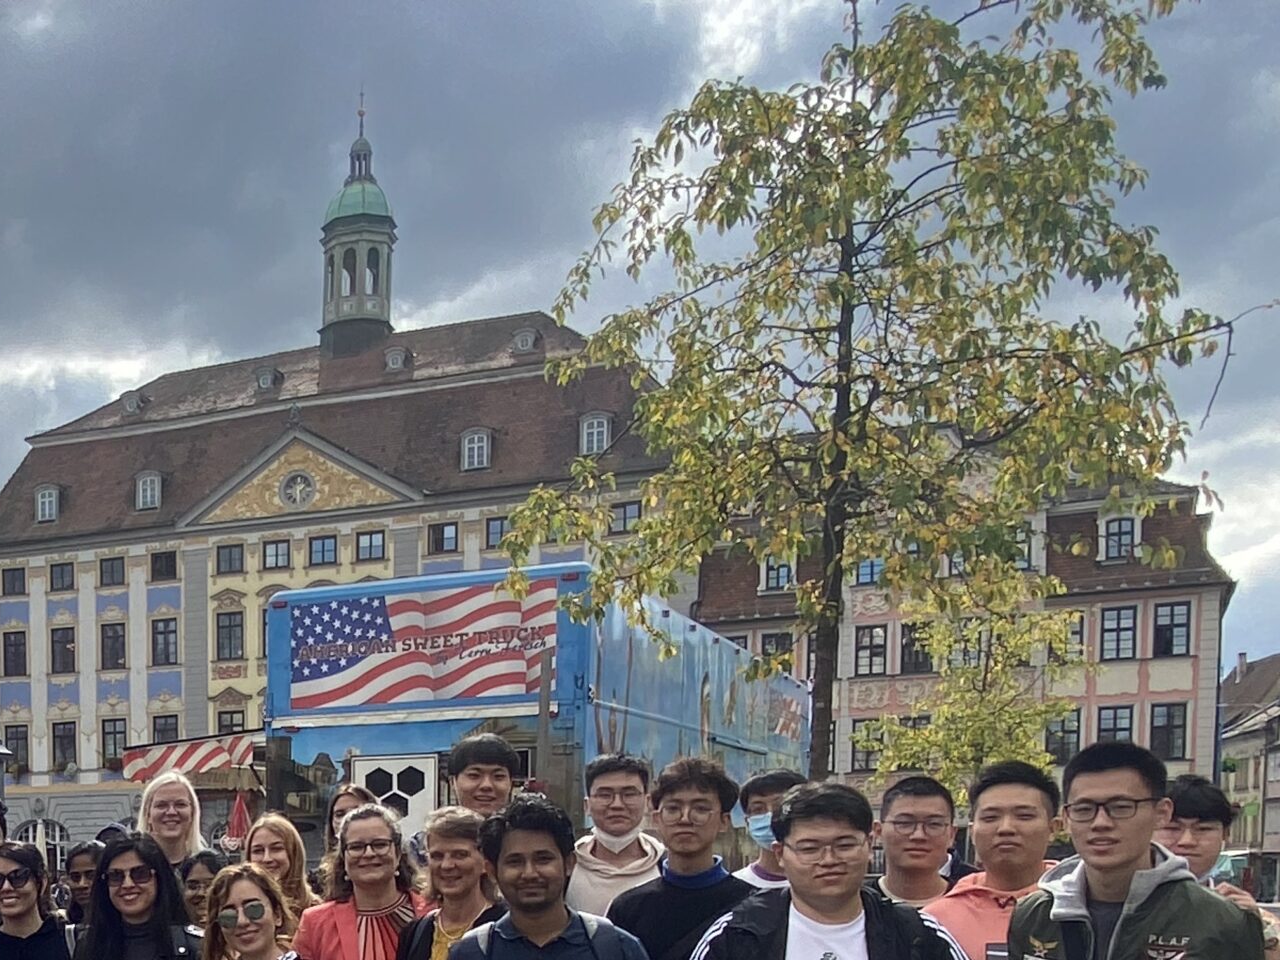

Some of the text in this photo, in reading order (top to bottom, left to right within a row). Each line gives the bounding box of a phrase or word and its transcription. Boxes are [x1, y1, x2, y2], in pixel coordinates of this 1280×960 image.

[298, 626, 546, 661] AMERICAN SWEET TRUCK
